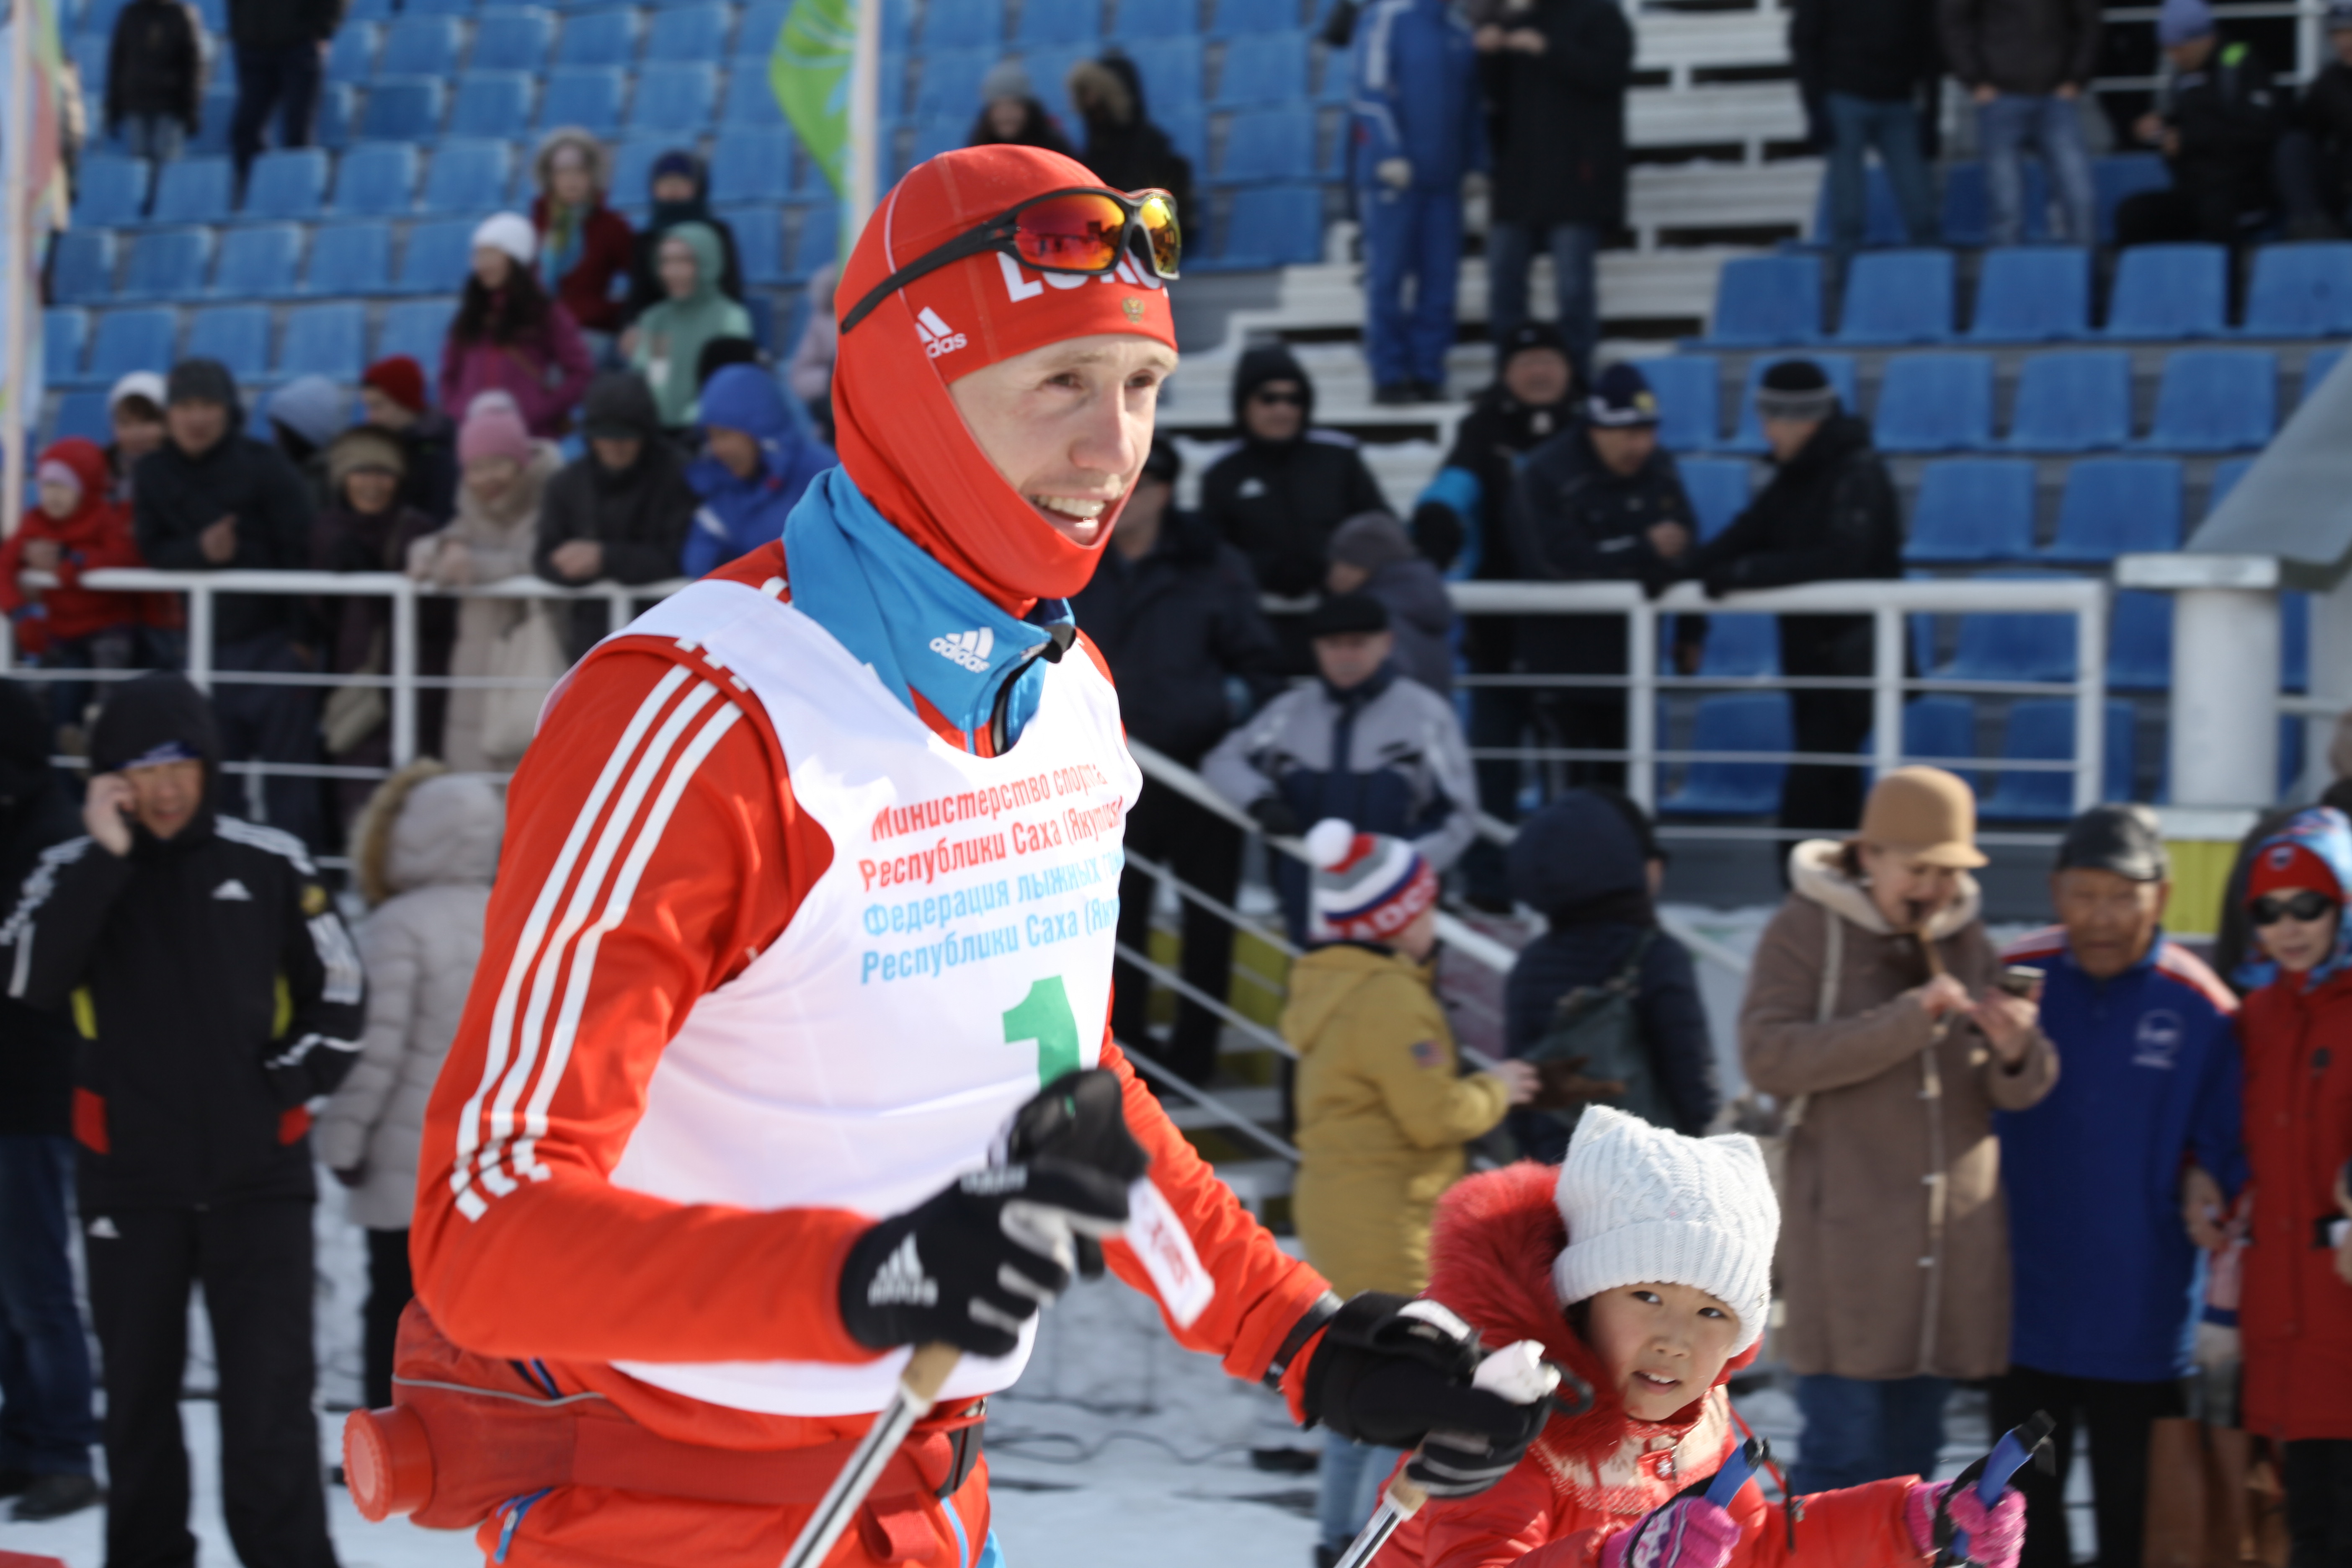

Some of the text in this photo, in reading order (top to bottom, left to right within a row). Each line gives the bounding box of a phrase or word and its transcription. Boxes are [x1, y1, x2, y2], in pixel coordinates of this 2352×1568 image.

[926, 333, 968, 358] das
[929, 637, 990, 673] adidas
[872, 773, 1050, 842] Министерство
[859, 833, 1006, 892] Республики
[1012, 820, 1062, 855] Саха
[863, 879, 1009, 936] Федерация
[1018, 857, 1102, 903] лыжных
[861, 925, 1019, 985] Республики
[1026, 910, 1078, 947] Саха
[1001, 974, 1081, 1091] 1
